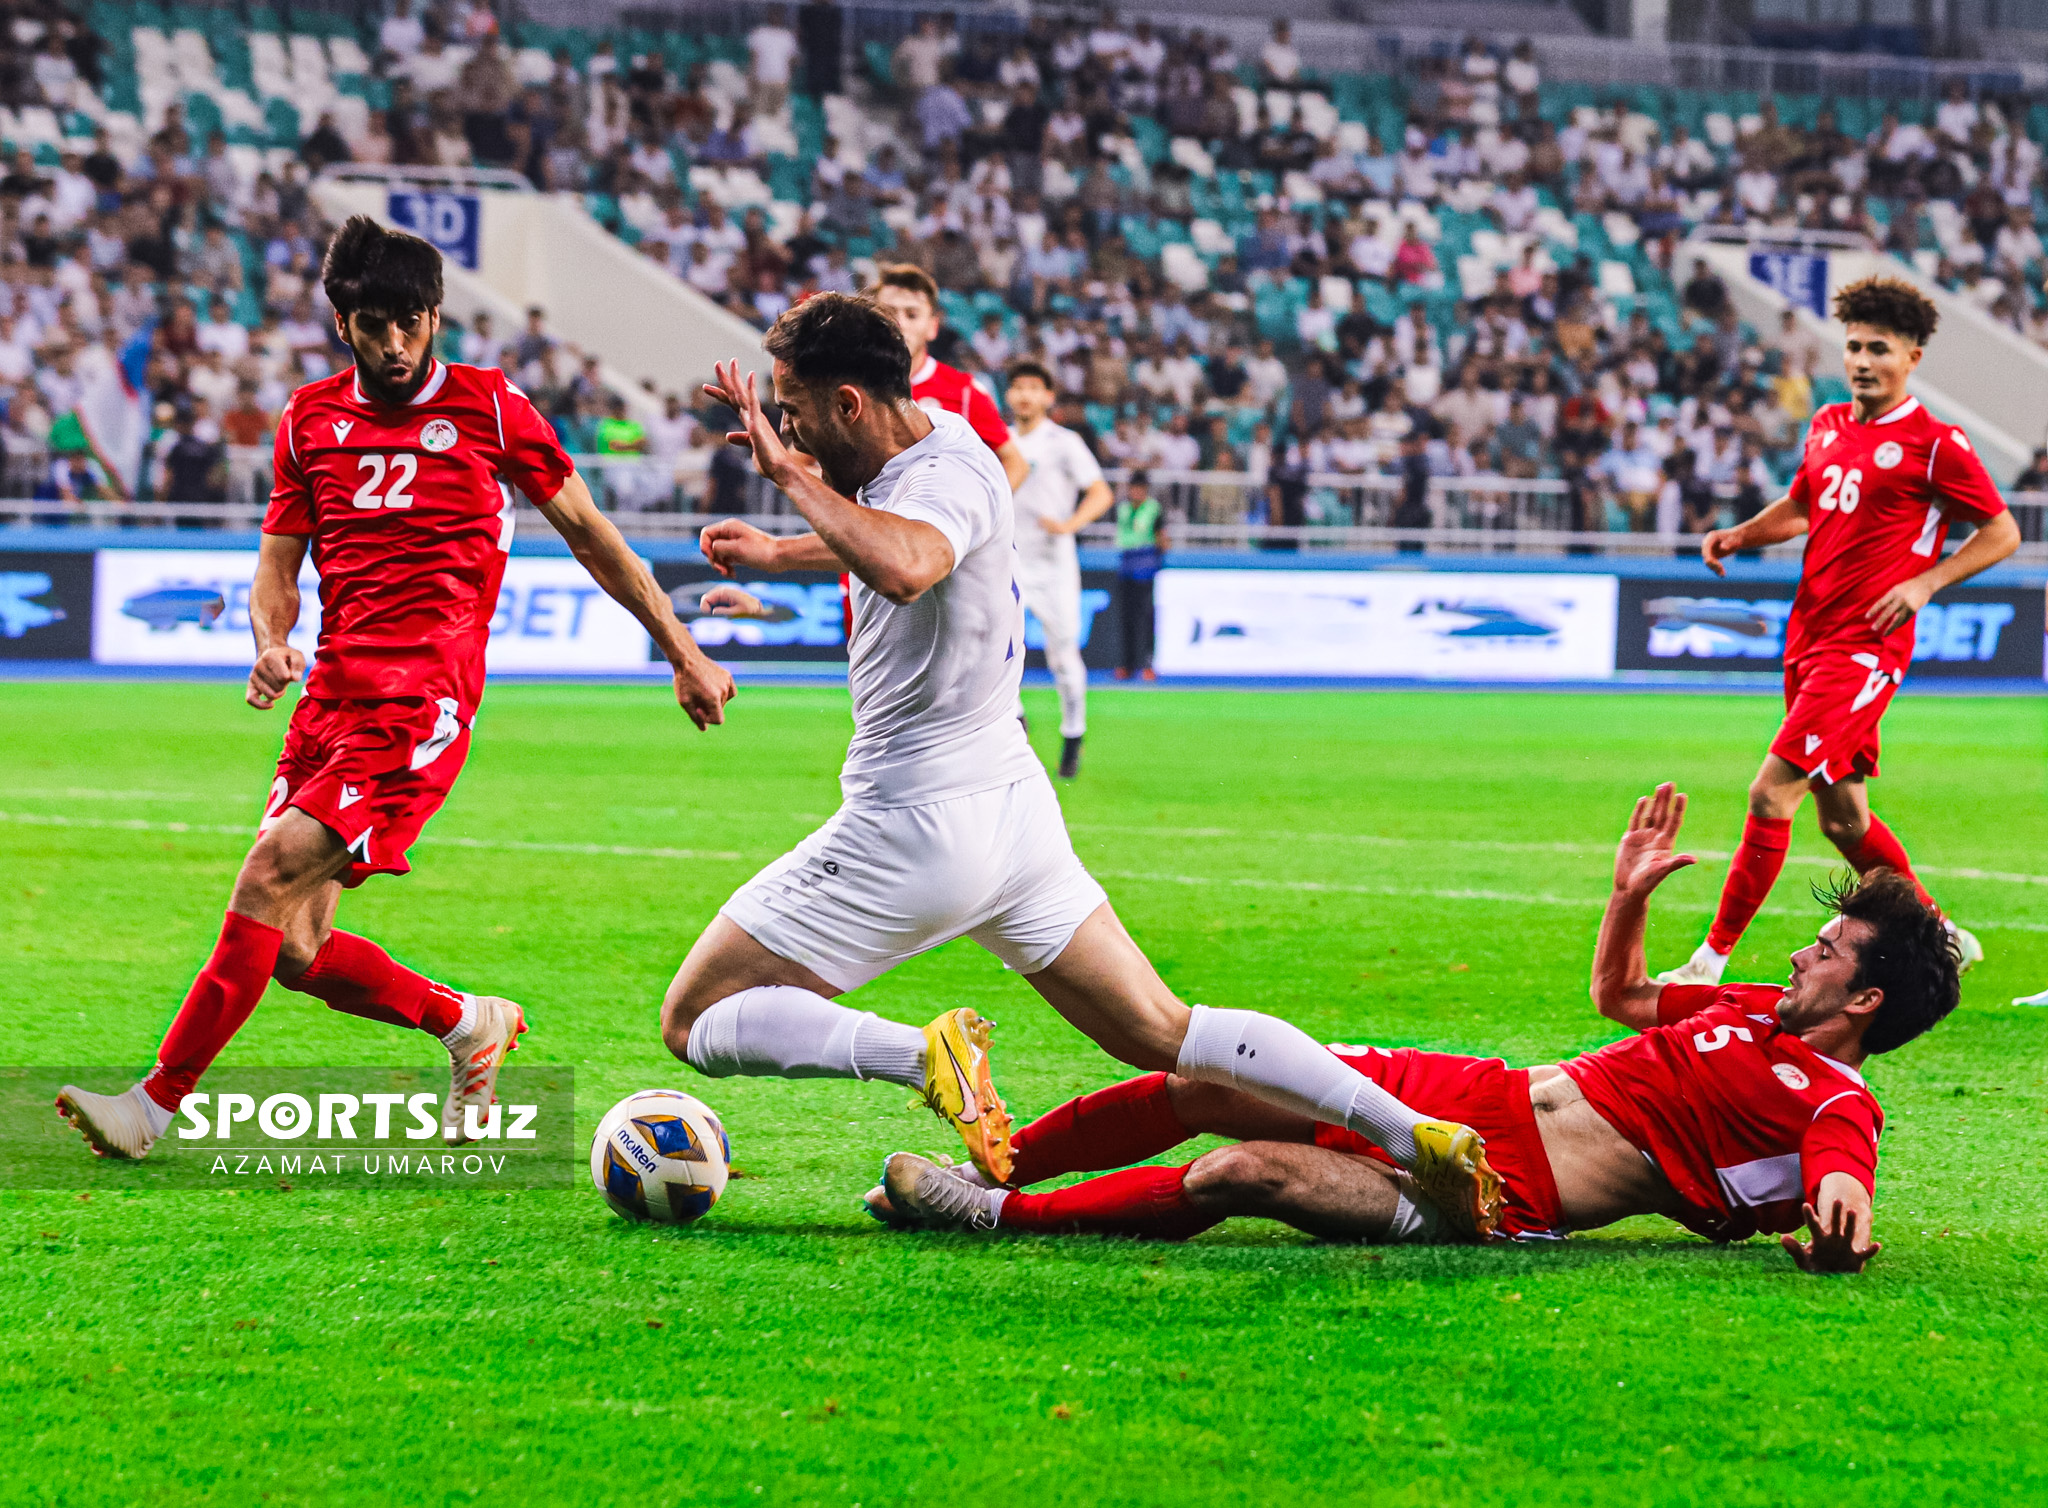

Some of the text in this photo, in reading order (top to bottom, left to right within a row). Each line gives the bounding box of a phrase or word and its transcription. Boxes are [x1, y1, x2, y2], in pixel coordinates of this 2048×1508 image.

[409, 196, 466, 243] 1D
[352, 452, 418, 509] 22
[1818, 464, 1863, 514] 26
[1693, 1024, 1754, 1053] 5
[617, 1129, 658, 1174] molten
